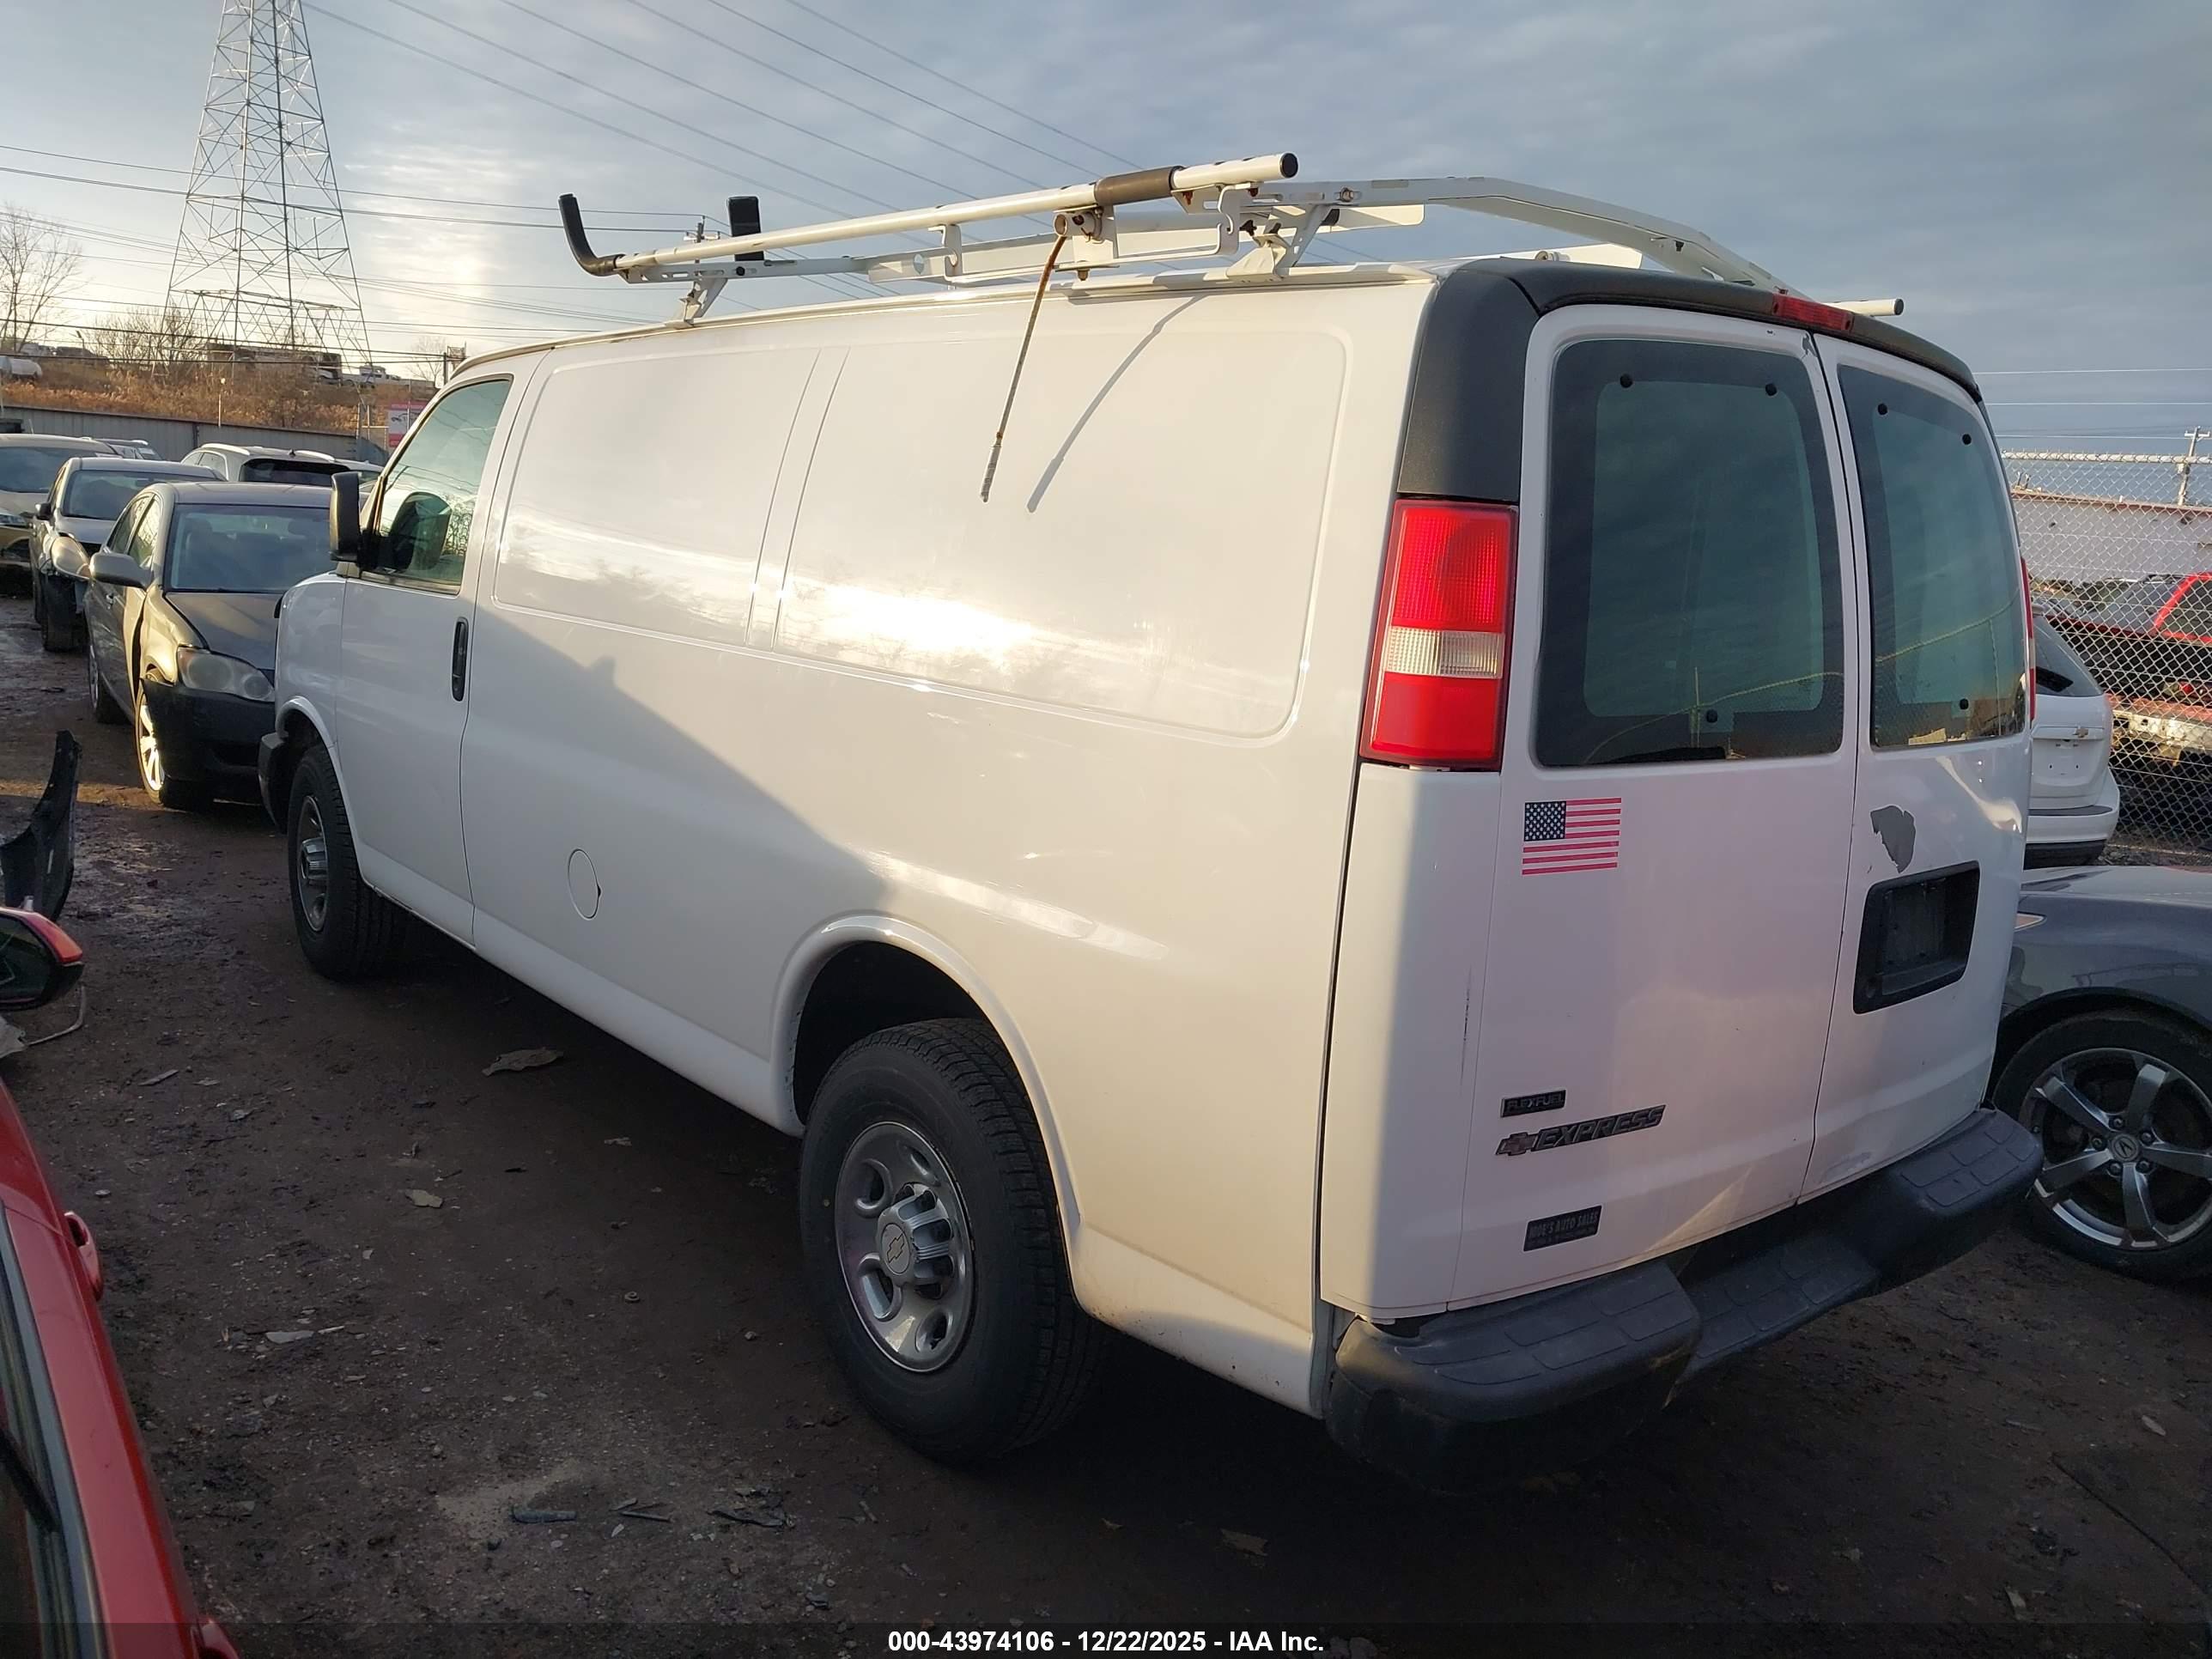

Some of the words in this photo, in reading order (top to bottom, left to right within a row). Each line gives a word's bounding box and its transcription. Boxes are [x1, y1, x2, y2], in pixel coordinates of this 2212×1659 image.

[1506, 1093, 1565, 1113] FLEXFUEL
[1535, 1105, 1665, 1151] EXPRESS
[1555, 1216, 1577, 1232] AUTO
[1578, 1209, 1600, 1228] SALES
